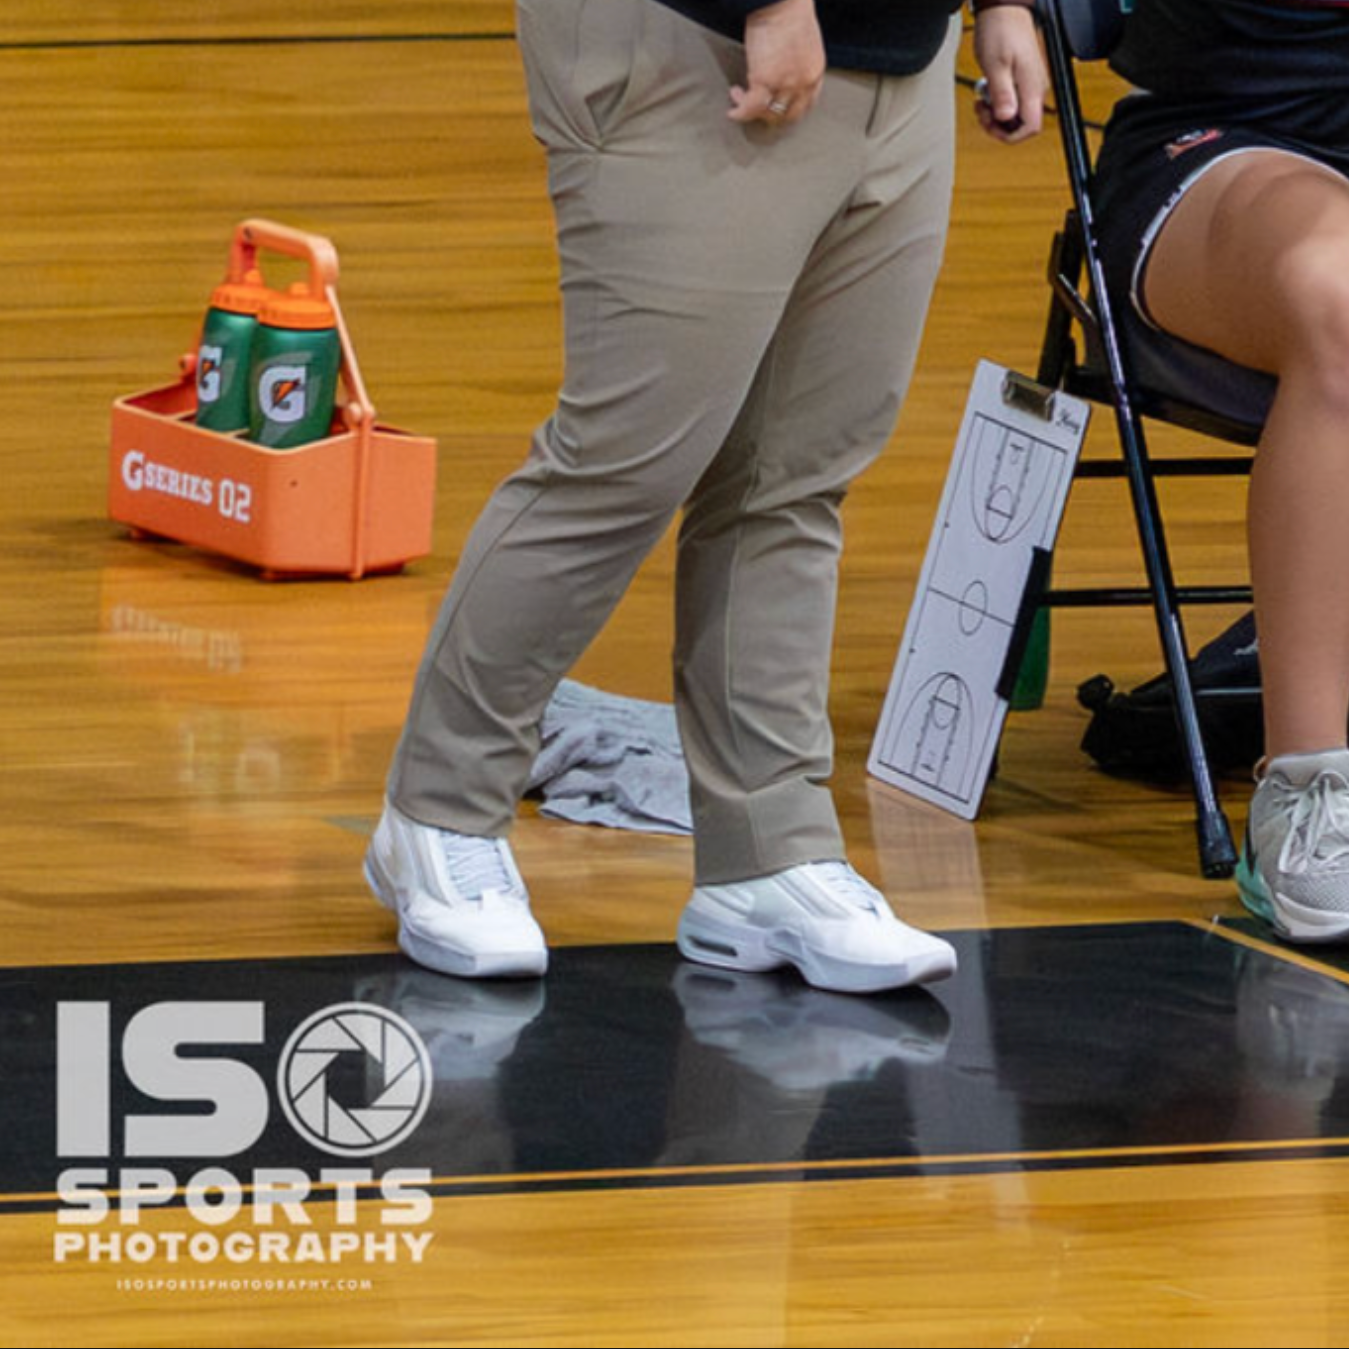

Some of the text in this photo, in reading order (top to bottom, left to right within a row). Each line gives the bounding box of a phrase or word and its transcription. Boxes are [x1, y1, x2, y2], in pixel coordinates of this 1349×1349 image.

[197, 344, 222, 402] G
[258, 366, 306, 423] G
[219, 479, 251, 524] 02
